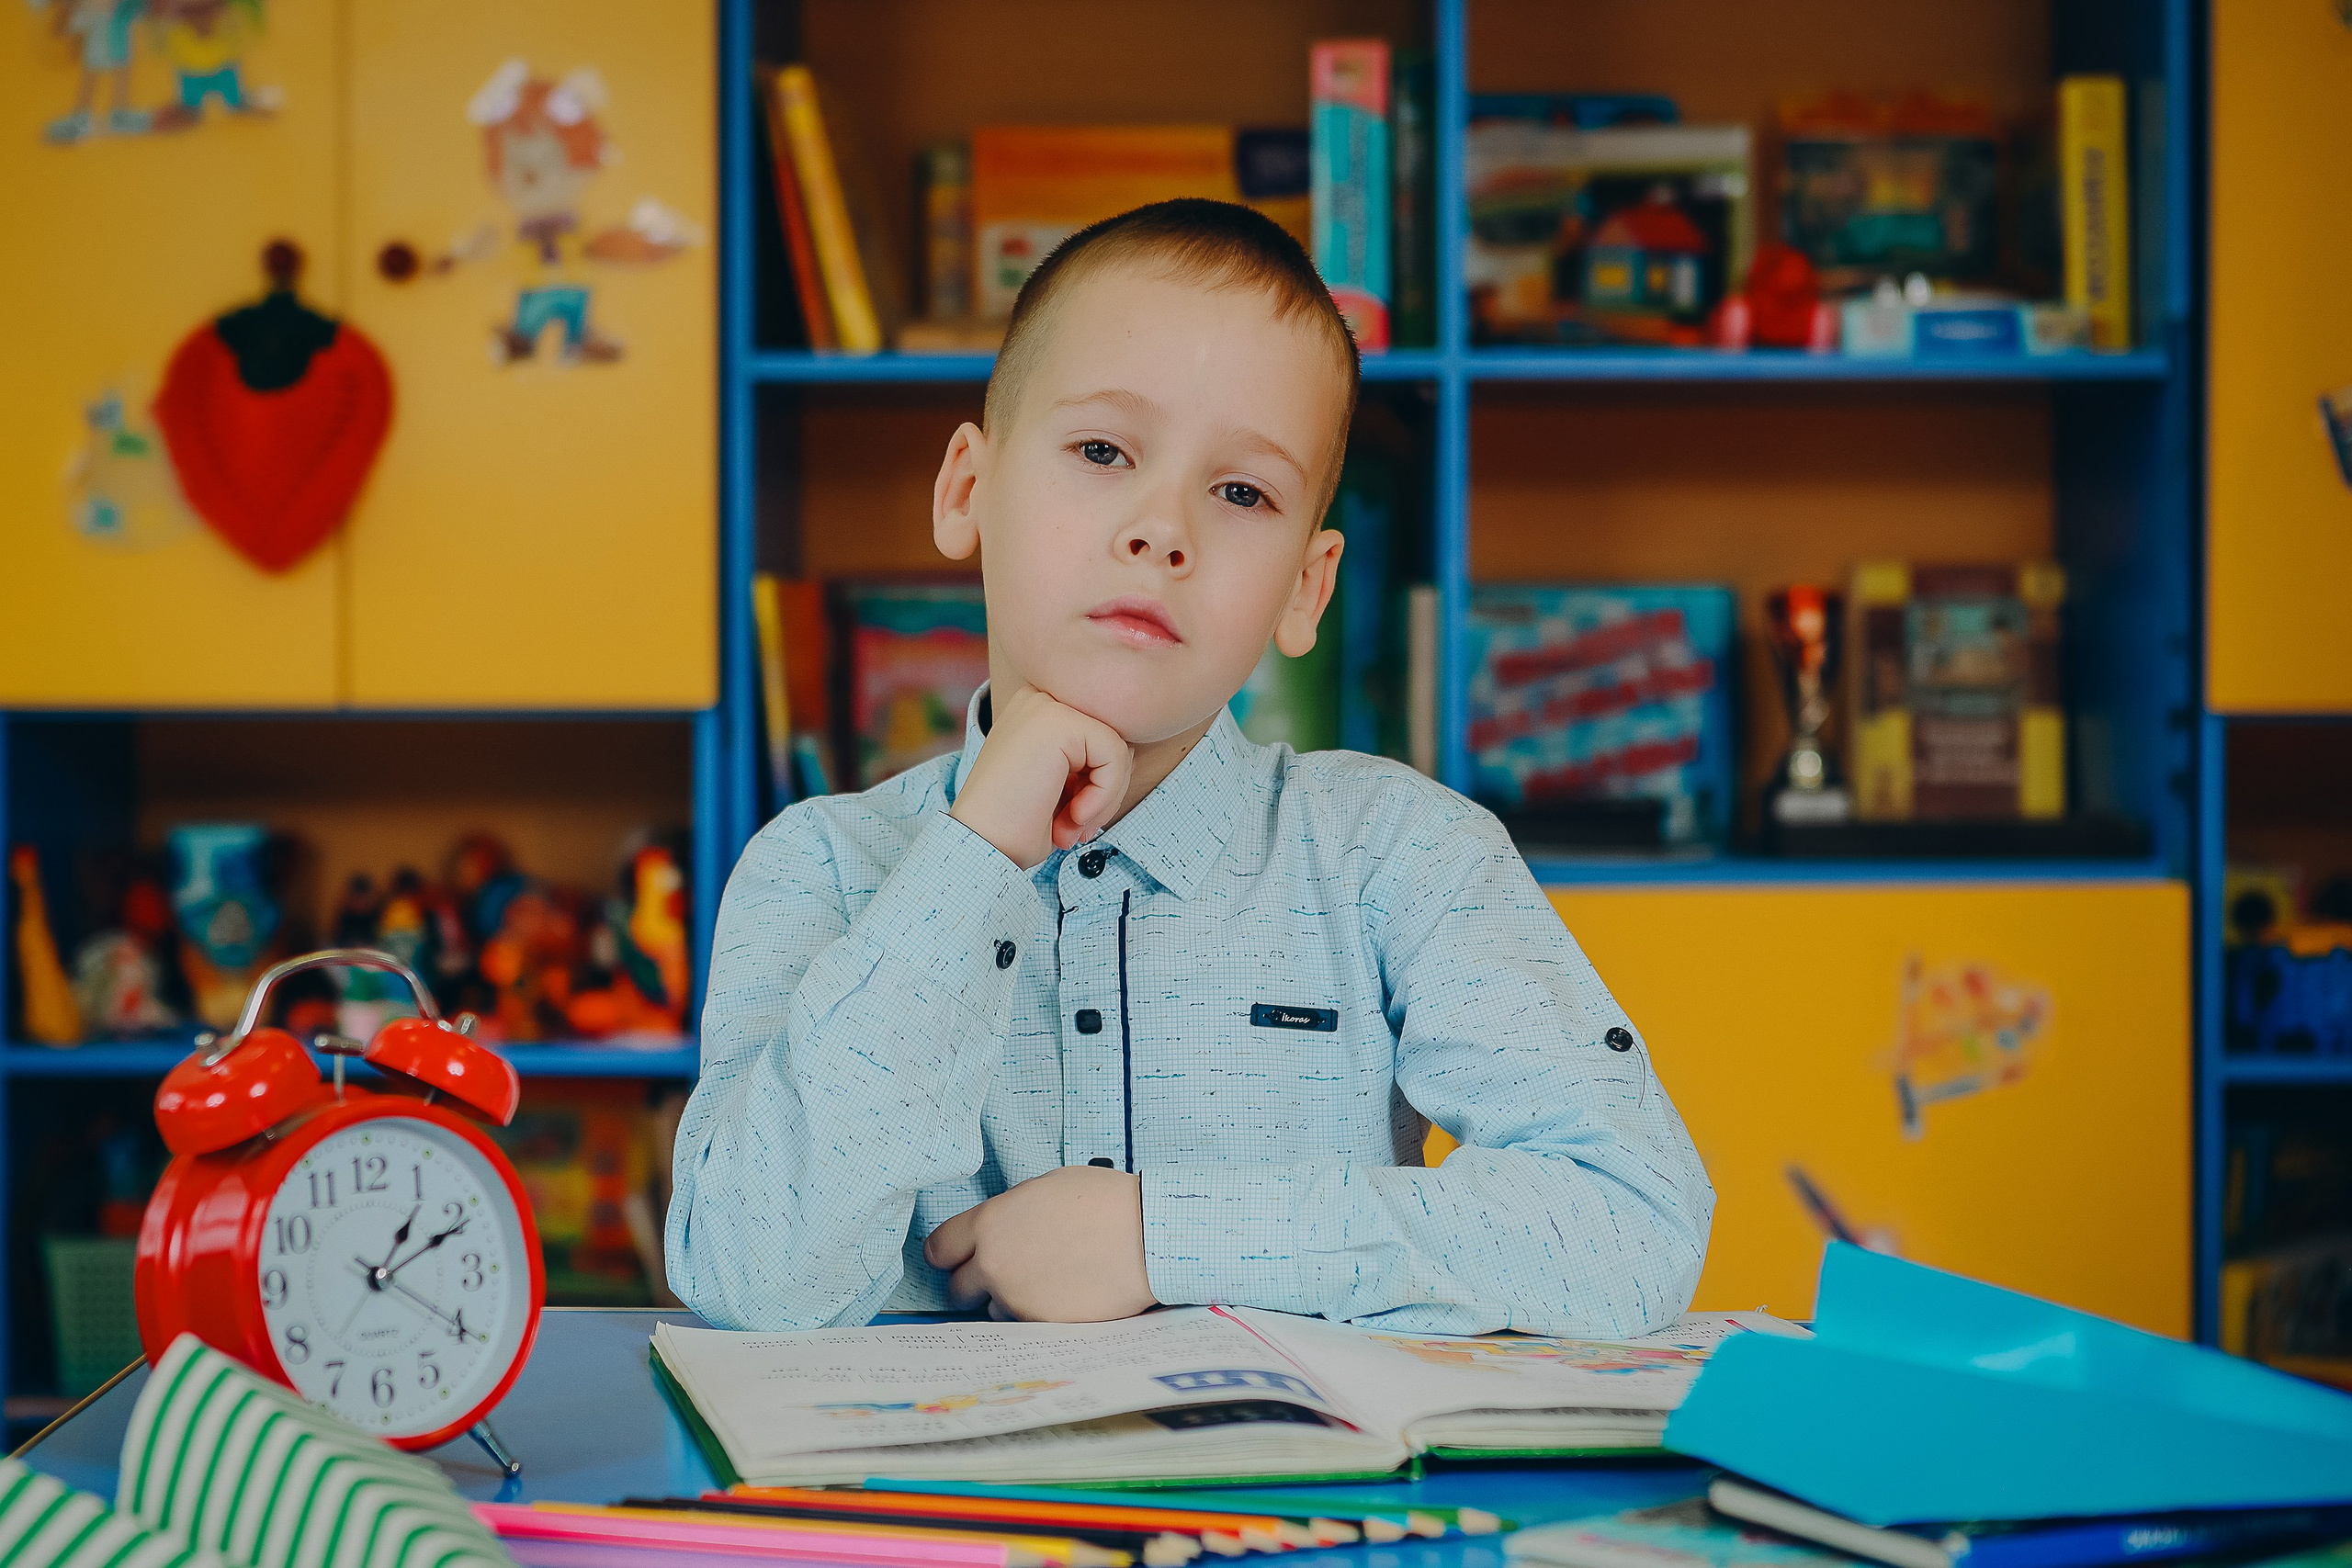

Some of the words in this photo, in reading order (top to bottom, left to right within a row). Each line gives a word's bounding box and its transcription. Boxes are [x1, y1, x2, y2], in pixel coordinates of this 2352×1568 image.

[309, 1170, 337, 1209] 11
[352, 1156, 389, 1194] 12
[412, 1166, 424, 1201] 1
[275, 1215, 311, 1256] 10
[443, 1201, 466, 1235] 2
[262, 1269, 287, 1311] 9
[461, 1253, 483, 1292] 3
[285, 1325, 311, 1365] 8
[447, 1306, 469, 1346] 4
[324, 1359, 346, 1398] 7
[371, 1368, 395, 1408] 6
[417, 1349, 439, 1390] 5
